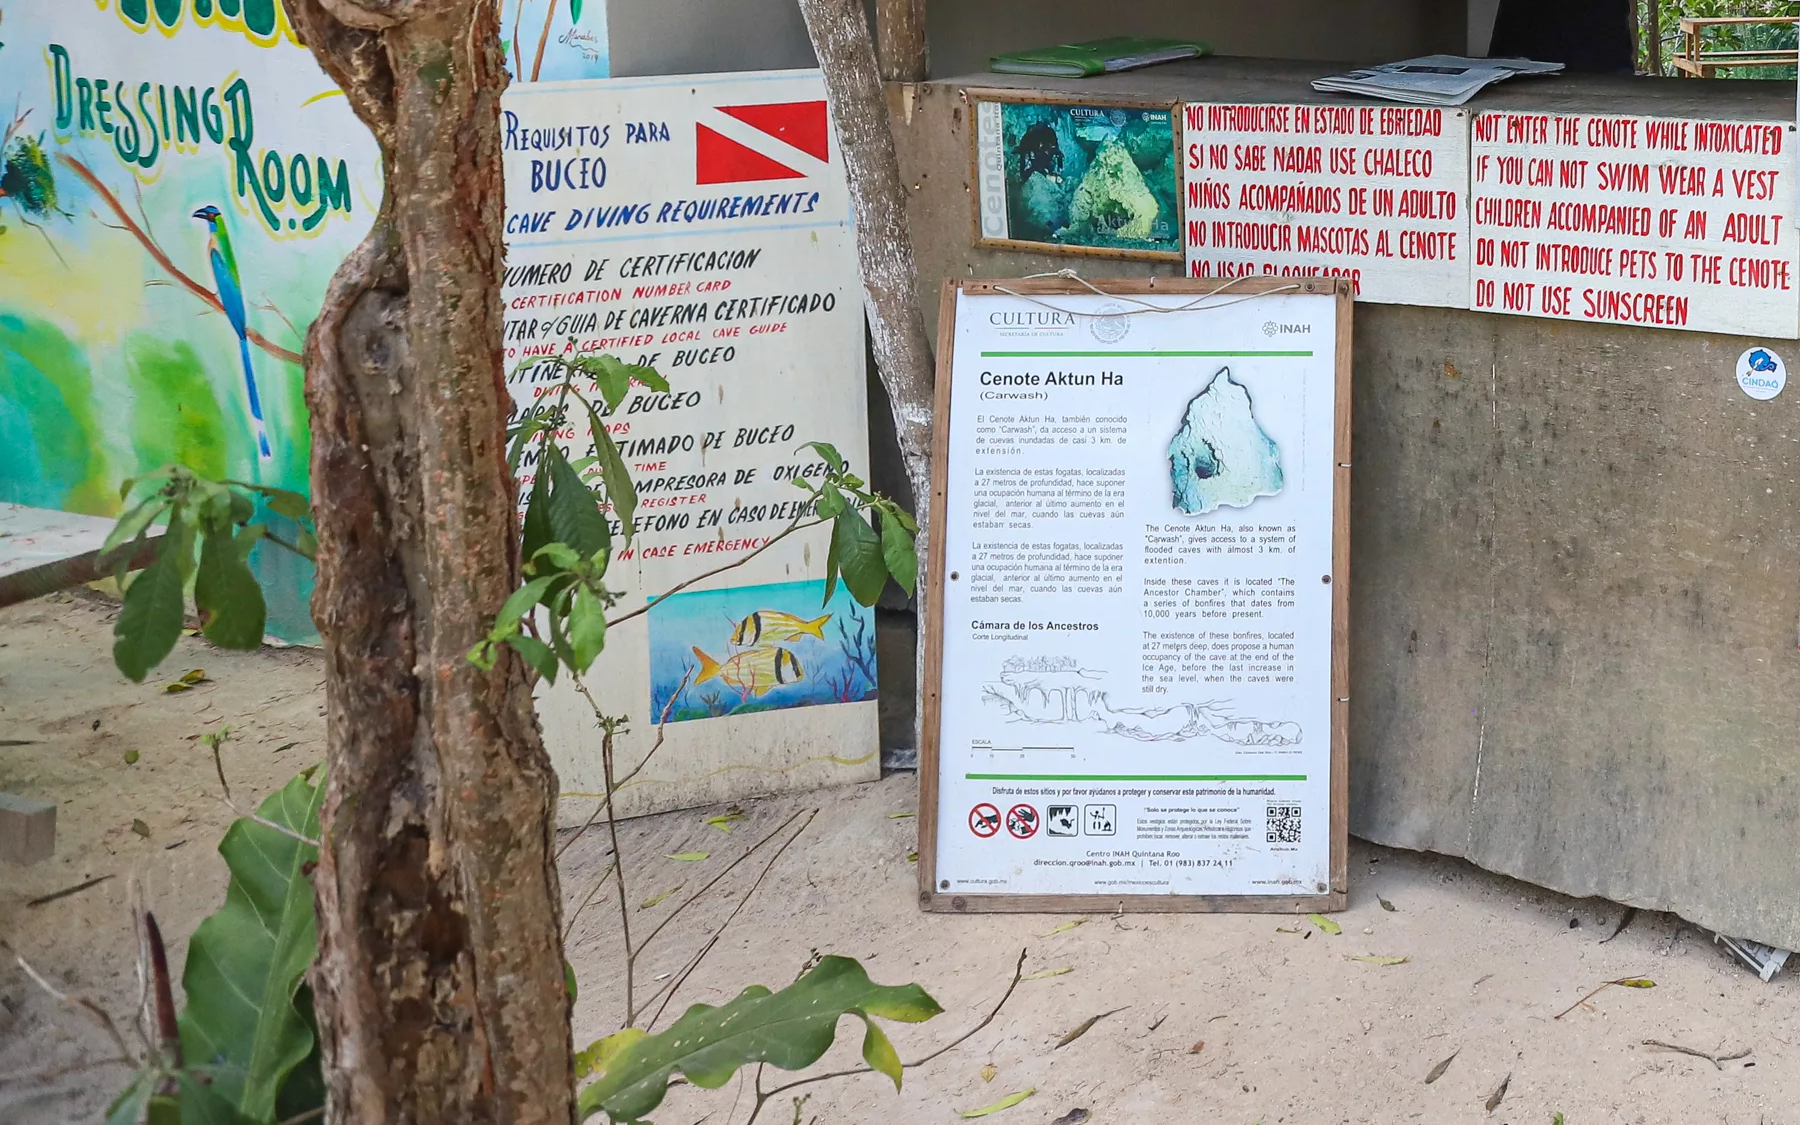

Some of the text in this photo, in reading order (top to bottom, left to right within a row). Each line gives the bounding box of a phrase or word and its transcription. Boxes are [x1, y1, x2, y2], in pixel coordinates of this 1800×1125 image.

[625, 123, 671, 144] PARA
[1188, 106, 1441, 137] NO INTRODUCIRSE EN ESTADO DE EBRIEDAD
[1475, 114, 1781, 155] NOT ENTER THE CENOTE WHILE INTOXICATED
[1189, 144, 1433, 177] SI NO SABE NADAR USE CHALECO
[1476, 155, 1779, 201] IF YOU CAN NOT SWIM WEAR VEST
[507, 192, 820, 234] CAVE DIVING REQUIREMENTS
[1349, 187, 1367, 215] DE
[1373, 189, 1393, 216] UN
[1398, 189, 1456, 220] ADULTO
[1475, 197, 1783, 245] CHILDREN ACCOMPANIED OF AN ADULT
[1189, 221, 1206, 246] NO
[1212, 222, 1291, 252] INTRODUCIR
[1298, 226, 1370, 256] MASCOTAS
[1375, 230, 1393, 257] AL
[1400, 231, 1456, 260] CENOTE
[619, 249, 762, 278] CERTIFICACION
[1476, 238, 1790, 290] DO NOT INTRODUCE PETS TO THE CENOTE
[512, 279, 731, 309] CERTIFICATION NUMBER CARD
[1476, 279, 1688, 326] DO NOT USE SUNSCREEN
[629, 293, 836, 328] CAVERNA CERTIFICADO
[990, 312, 1075, 326] CULTURA
[662, 322, 787, 345] LOCAL CAVE GUIDE
[1279, 324, 1311, 333] INAH
[980, 372, 1124, 387] Cenote Aktun Ha
[980, 391, 1048, 401] (Carwash)
[971, 620, 1099, 631] Cámara Ancestros
[1132, 850, 1164, 858] Quintana
